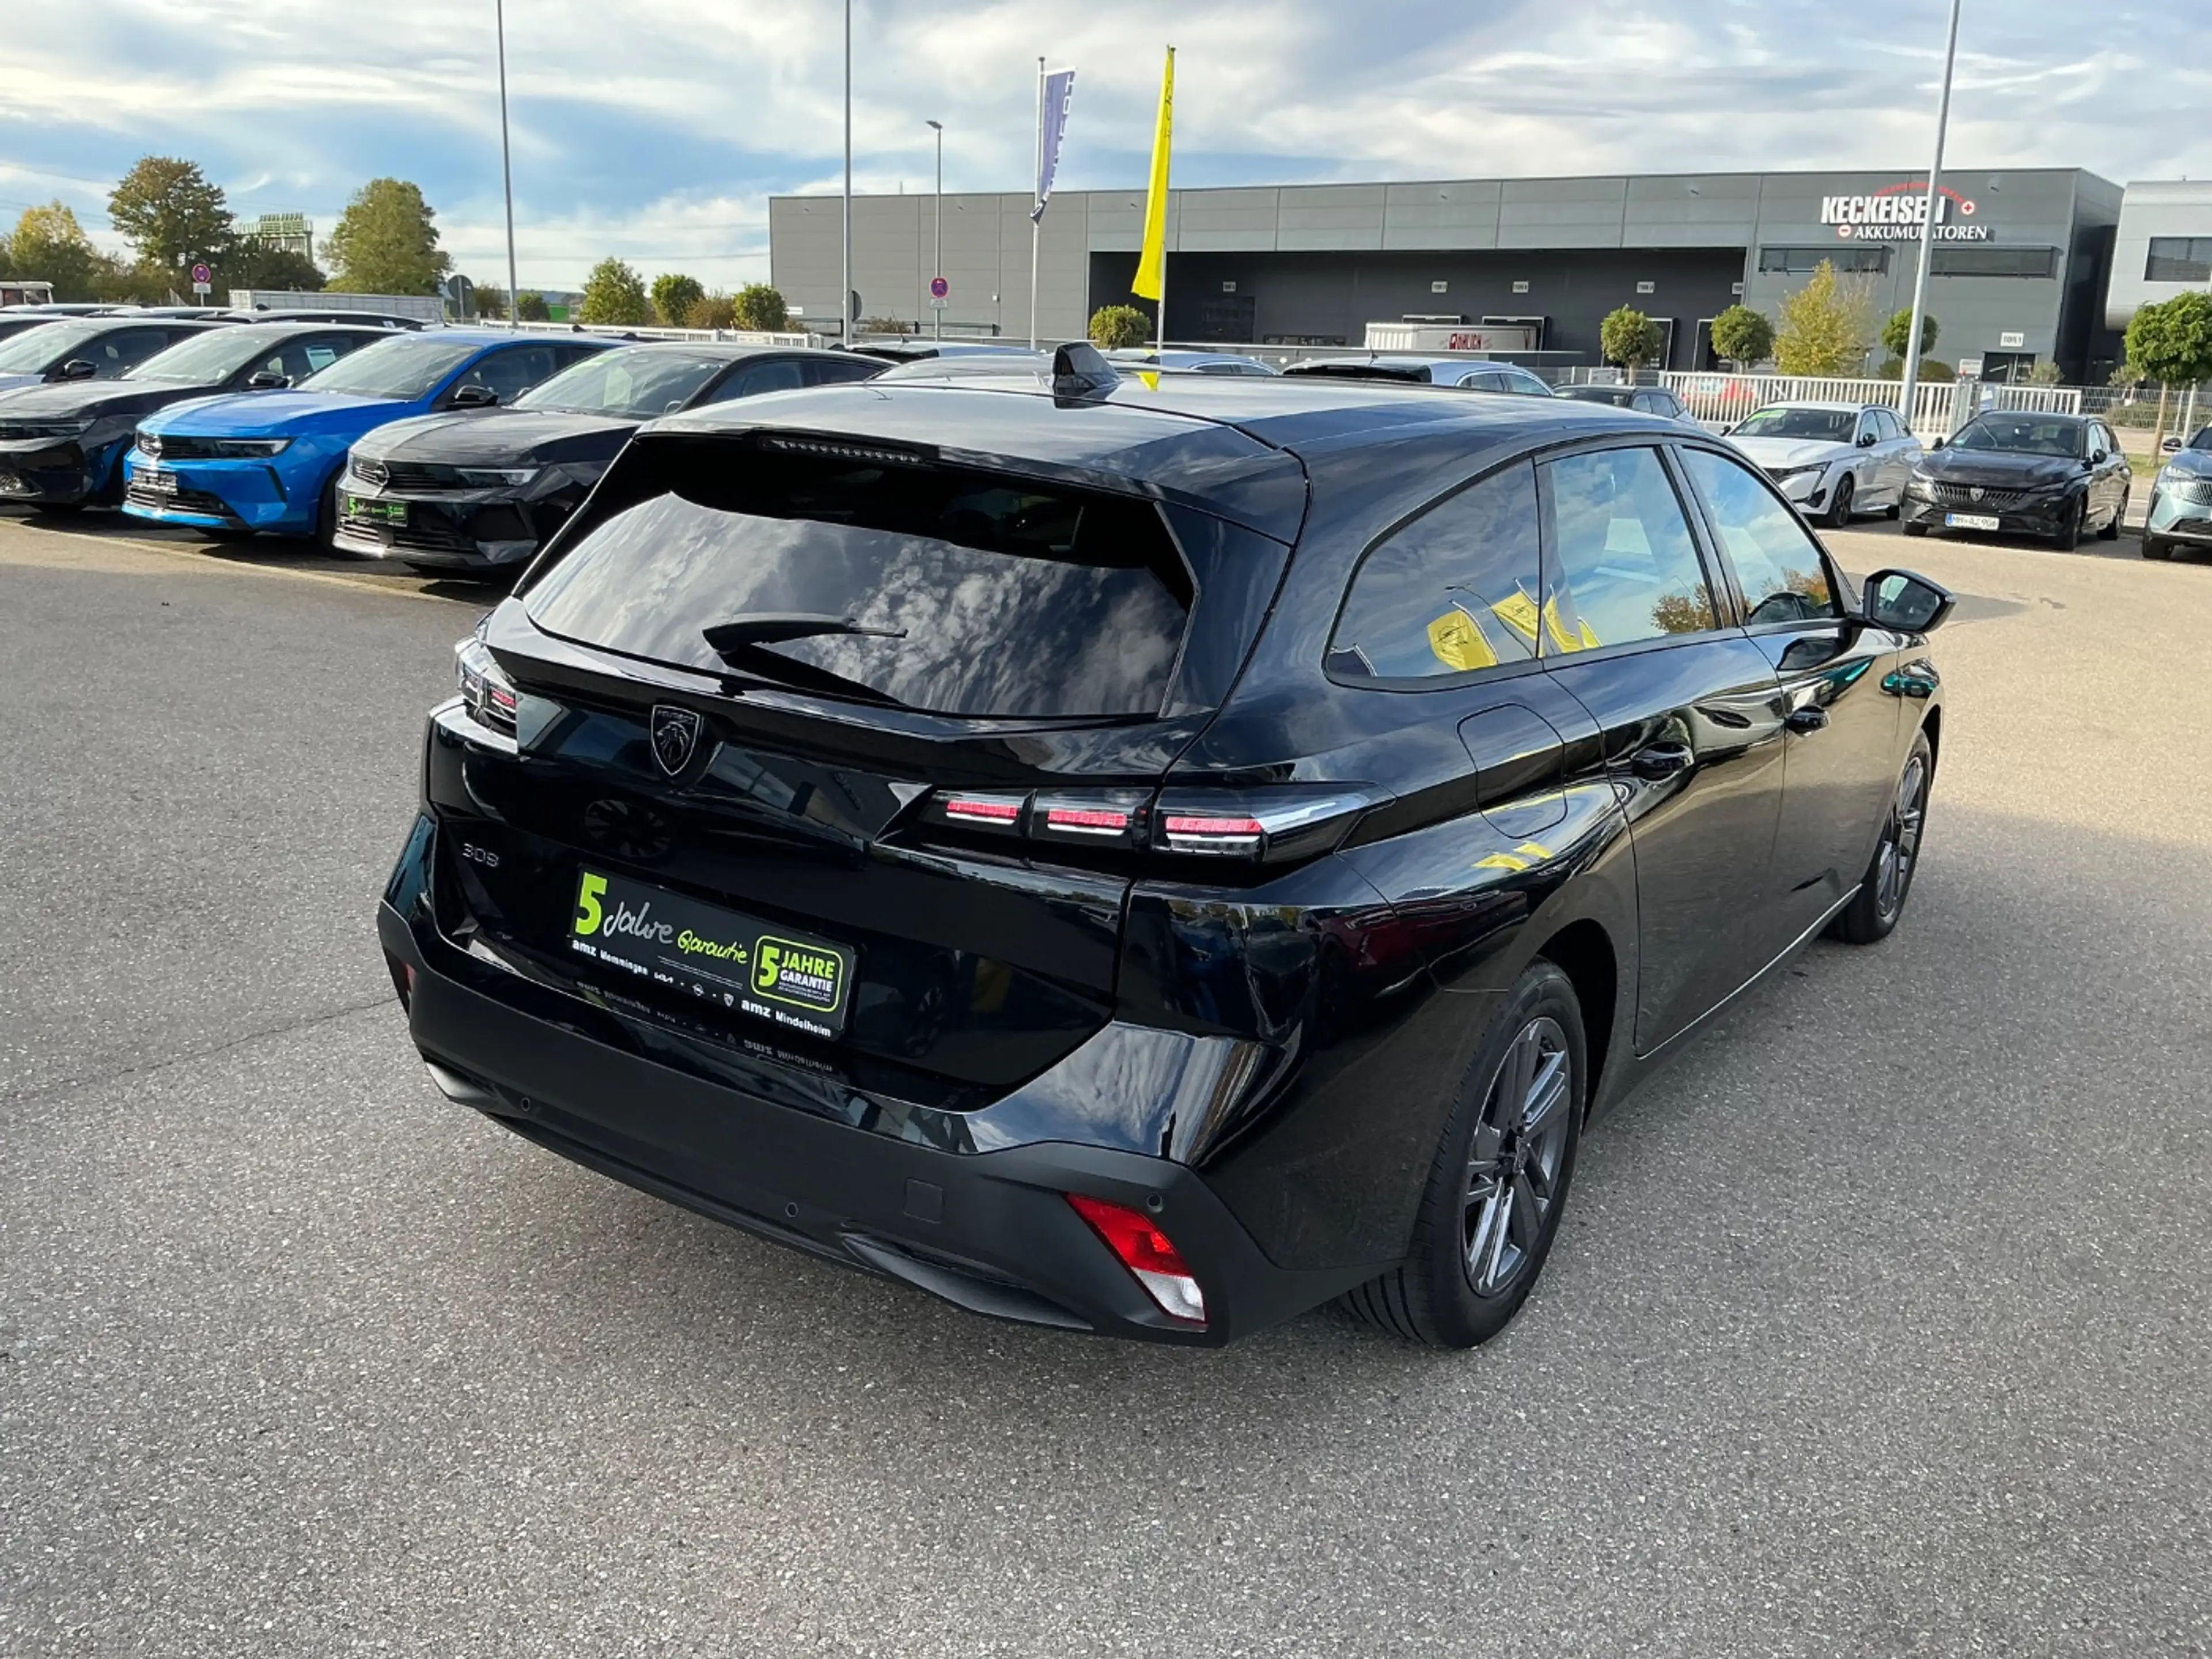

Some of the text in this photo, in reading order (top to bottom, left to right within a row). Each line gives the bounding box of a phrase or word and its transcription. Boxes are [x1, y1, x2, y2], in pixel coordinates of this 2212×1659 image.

[1821, 195, 1946, 224] KECKEISEN
[1853, 225, 1988, 240] AKKUMUTOREN
[462, 842, 499, 867] 308
[575, 871, 748, 964] 5 Jahre Garantie
[757, 945, 780, 987] 5
[781, 950, 835, 979] JAHRE
[779, 969, 834, 992] GARANTIE
[571, 939, 597, 957] amz
[741, 999, 772, 1018] amz
[775, 1010, 832, 1037] Mindelheim
